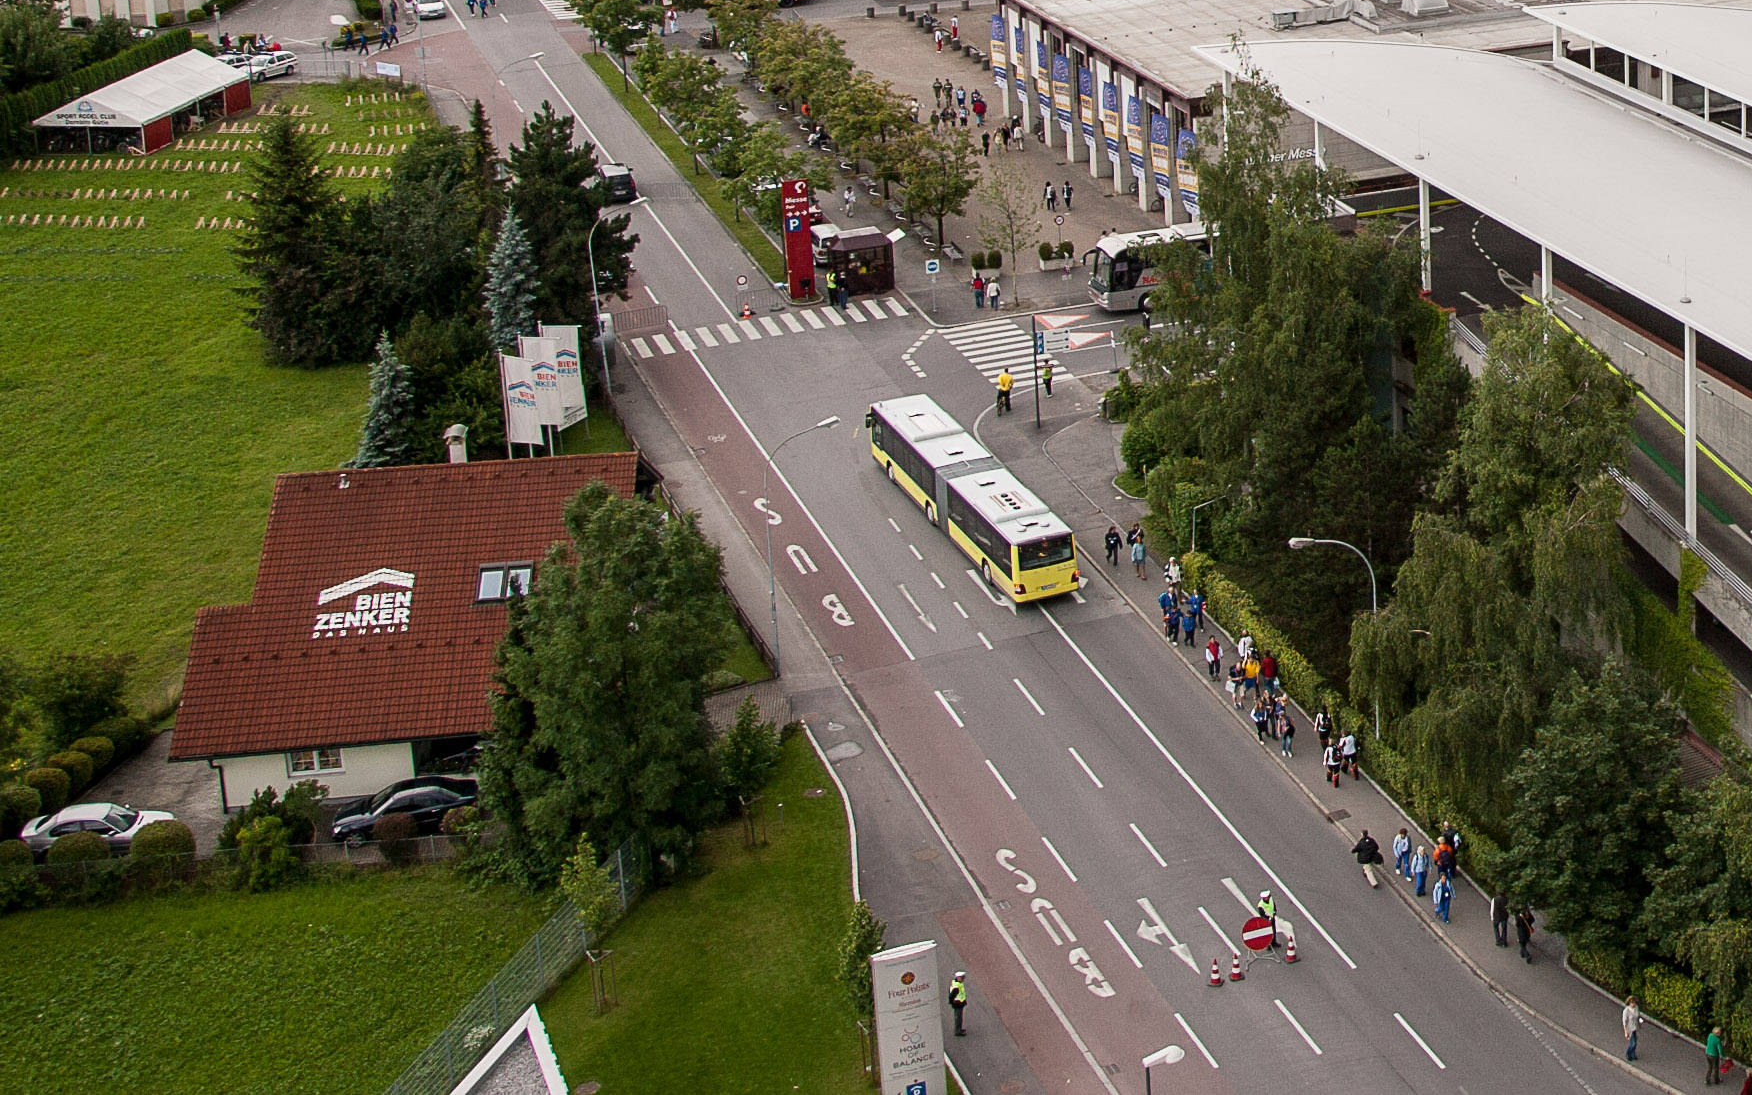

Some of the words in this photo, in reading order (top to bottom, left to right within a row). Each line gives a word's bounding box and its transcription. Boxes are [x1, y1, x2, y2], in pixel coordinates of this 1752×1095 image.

[789, 218, 800, 231] P
[537, 373, 557, 381] BIEN
[355, 590, 412, 611] BIEN
[314, 607, 411, 631] ZENKER
[312, 629, 347, 639] DAS
[358, 624, 409, 635] HAUS
[900, 1041, 926, 1054] HOME
[893, 1052, 935, 1069] BALANCE
